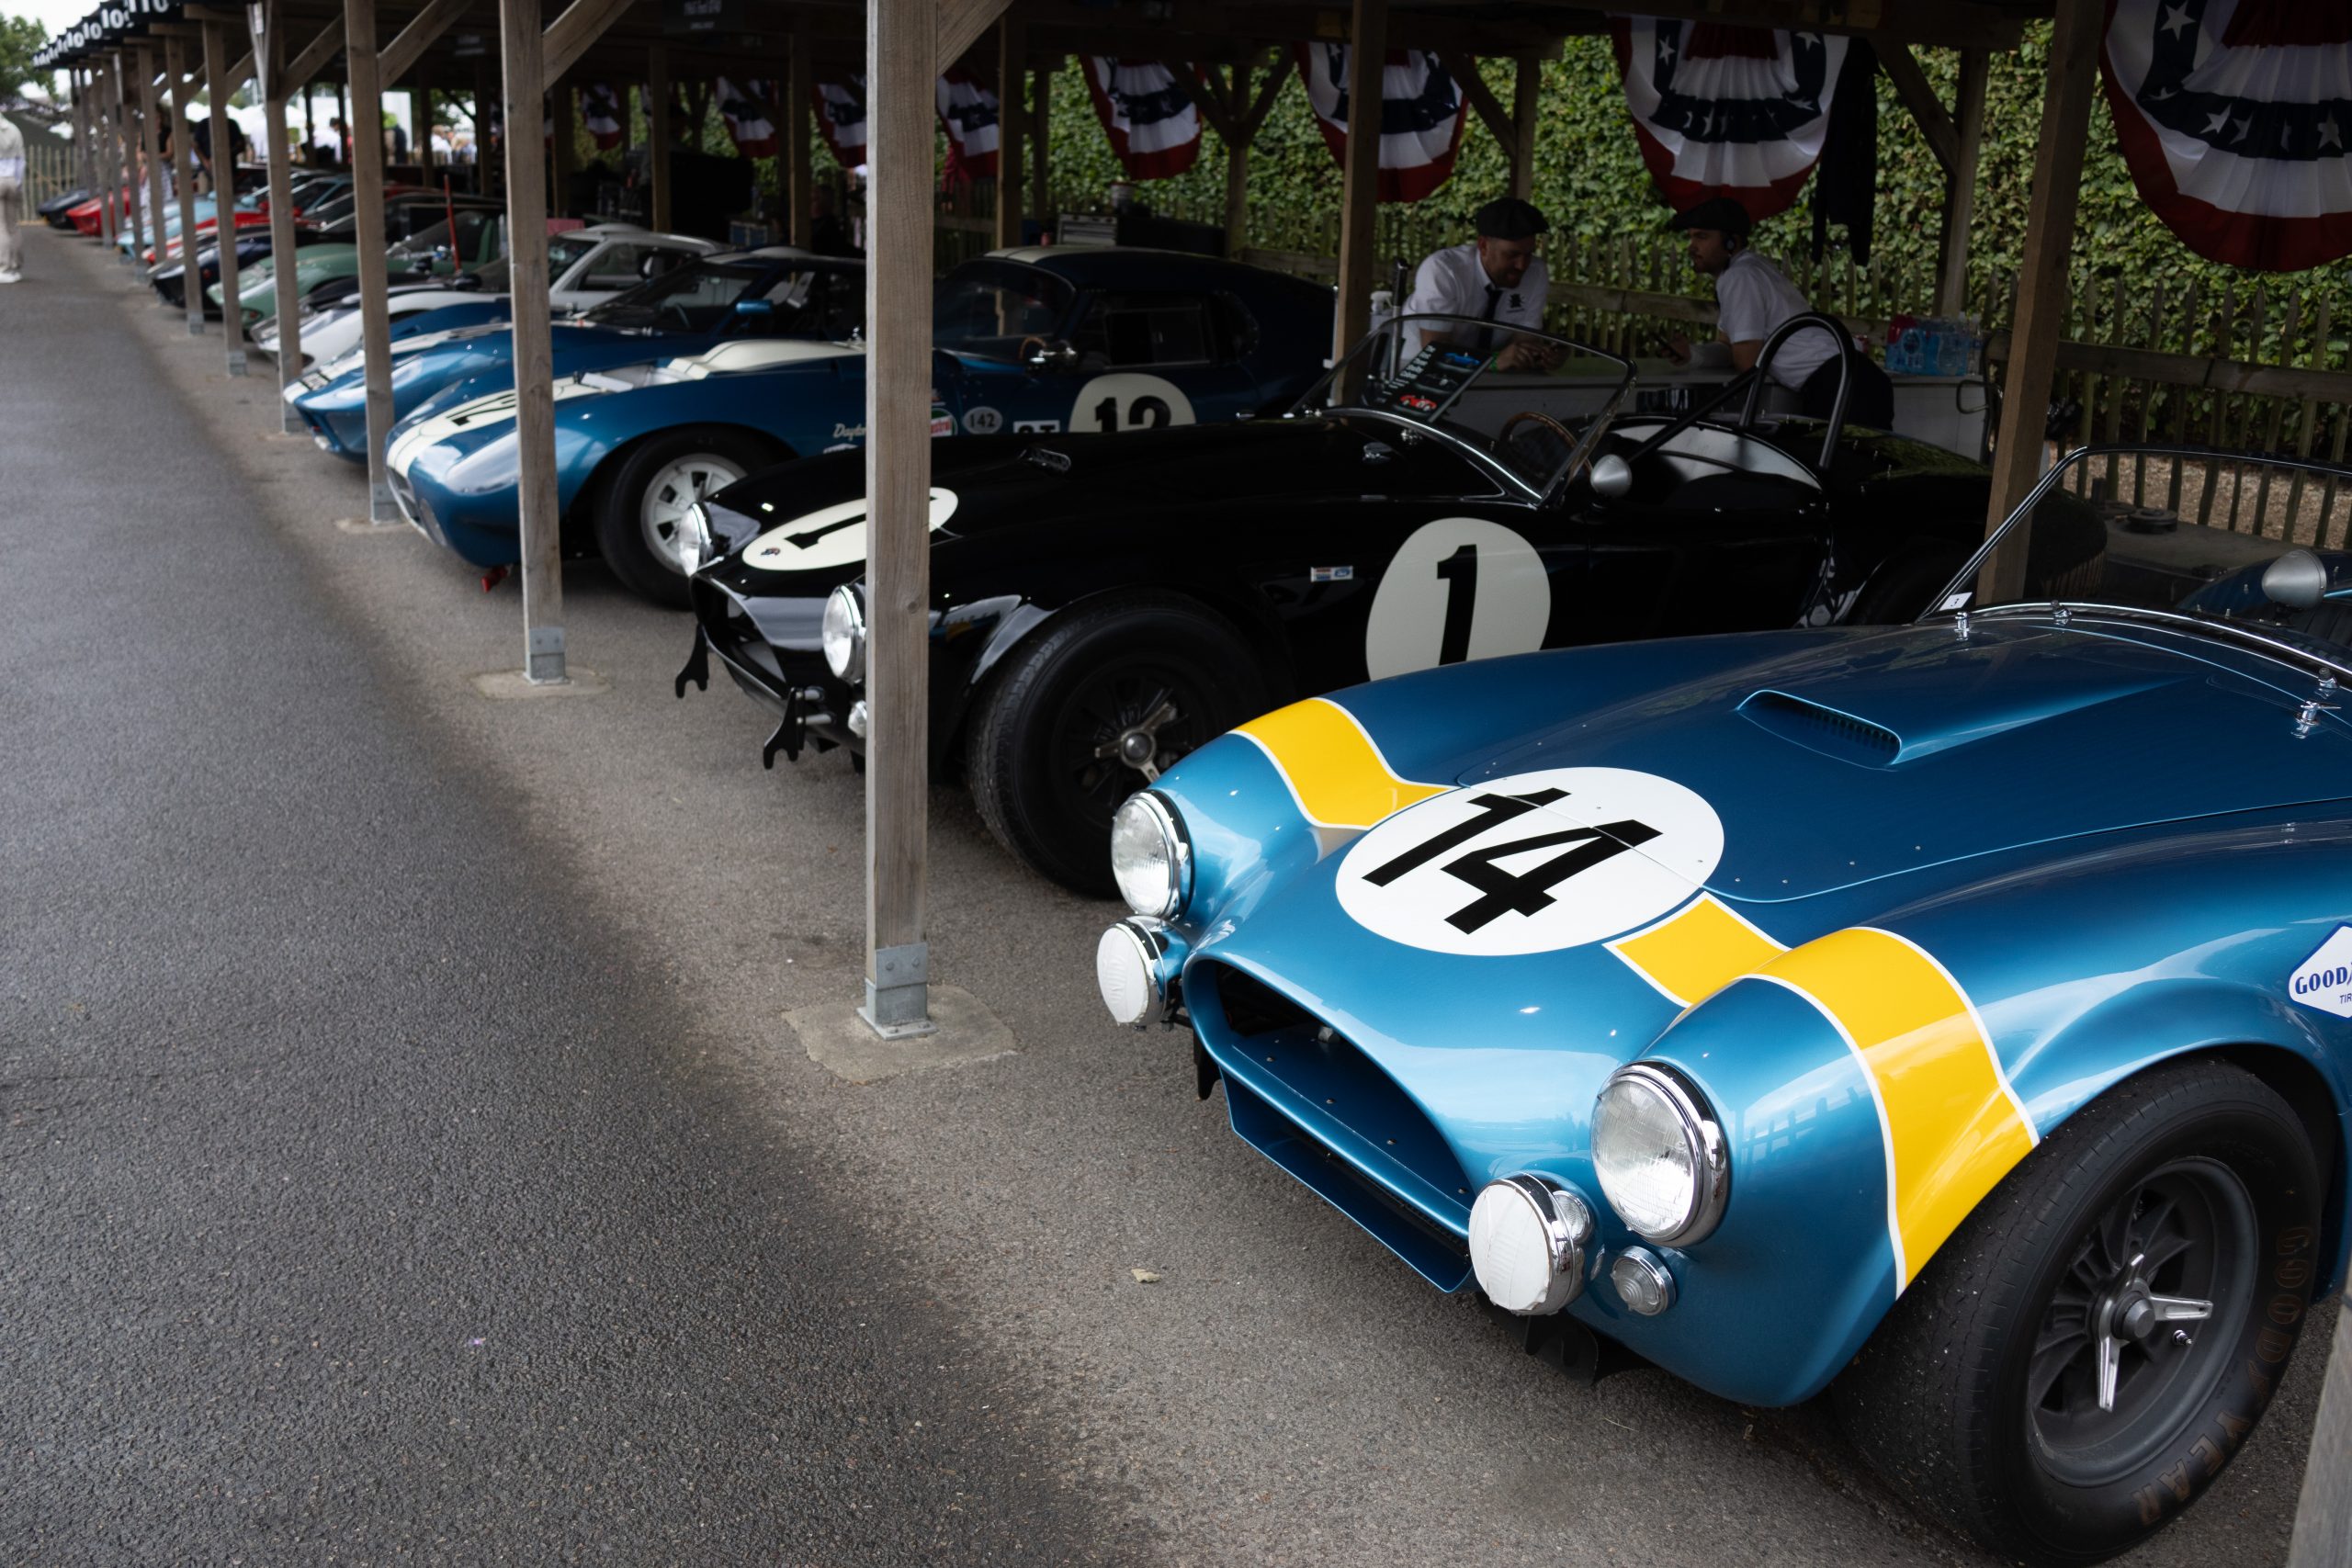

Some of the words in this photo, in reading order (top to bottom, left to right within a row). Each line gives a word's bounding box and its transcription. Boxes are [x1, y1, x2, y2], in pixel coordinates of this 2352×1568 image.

[968, 412, 996, 428] 142
[1436, 544, 1477, 666] 1
[1362, 786, 1663, 935] 14
[2295, 966, 2348, 995] GOOD
[2339, 992, 2352, 1004] TIR
